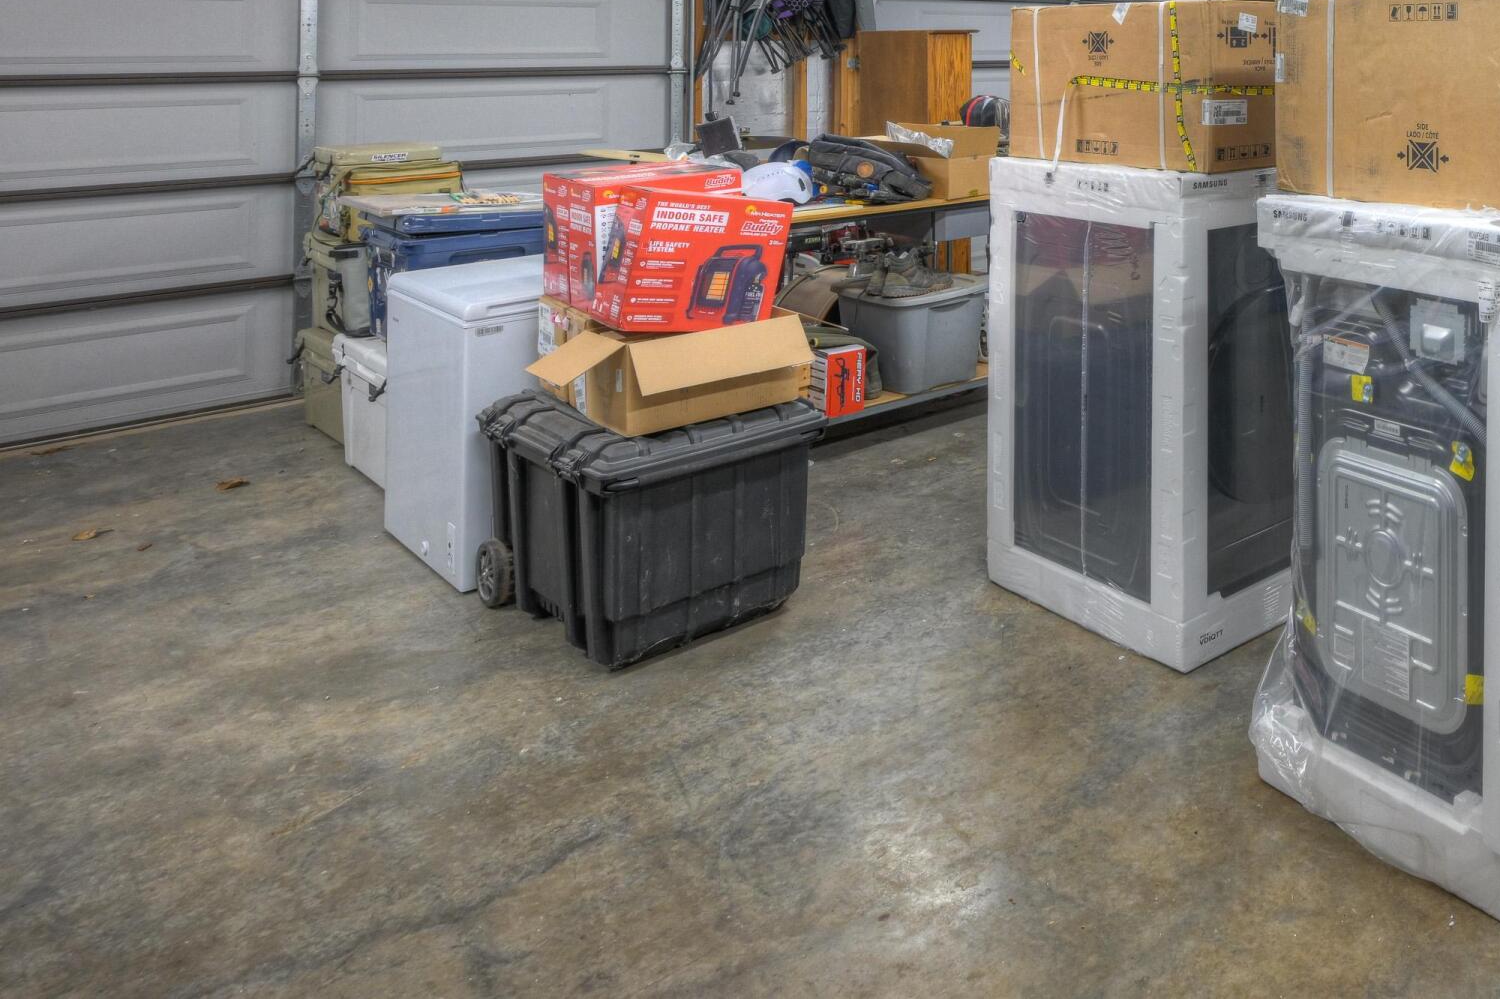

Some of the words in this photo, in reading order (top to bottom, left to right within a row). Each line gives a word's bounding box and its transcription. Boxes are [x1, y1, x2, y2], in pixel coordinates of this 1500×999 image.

[1416, 123, 1429, 131] SIDE
[1192, 178, 1228, 190] SAMSUNG
[656, 210, 696, 220] INDOOR
[699, 213, 725, 223] SAFE
[650, 222, 690, 232] PROPANE
[742, 221, 783, 234] Buddy
